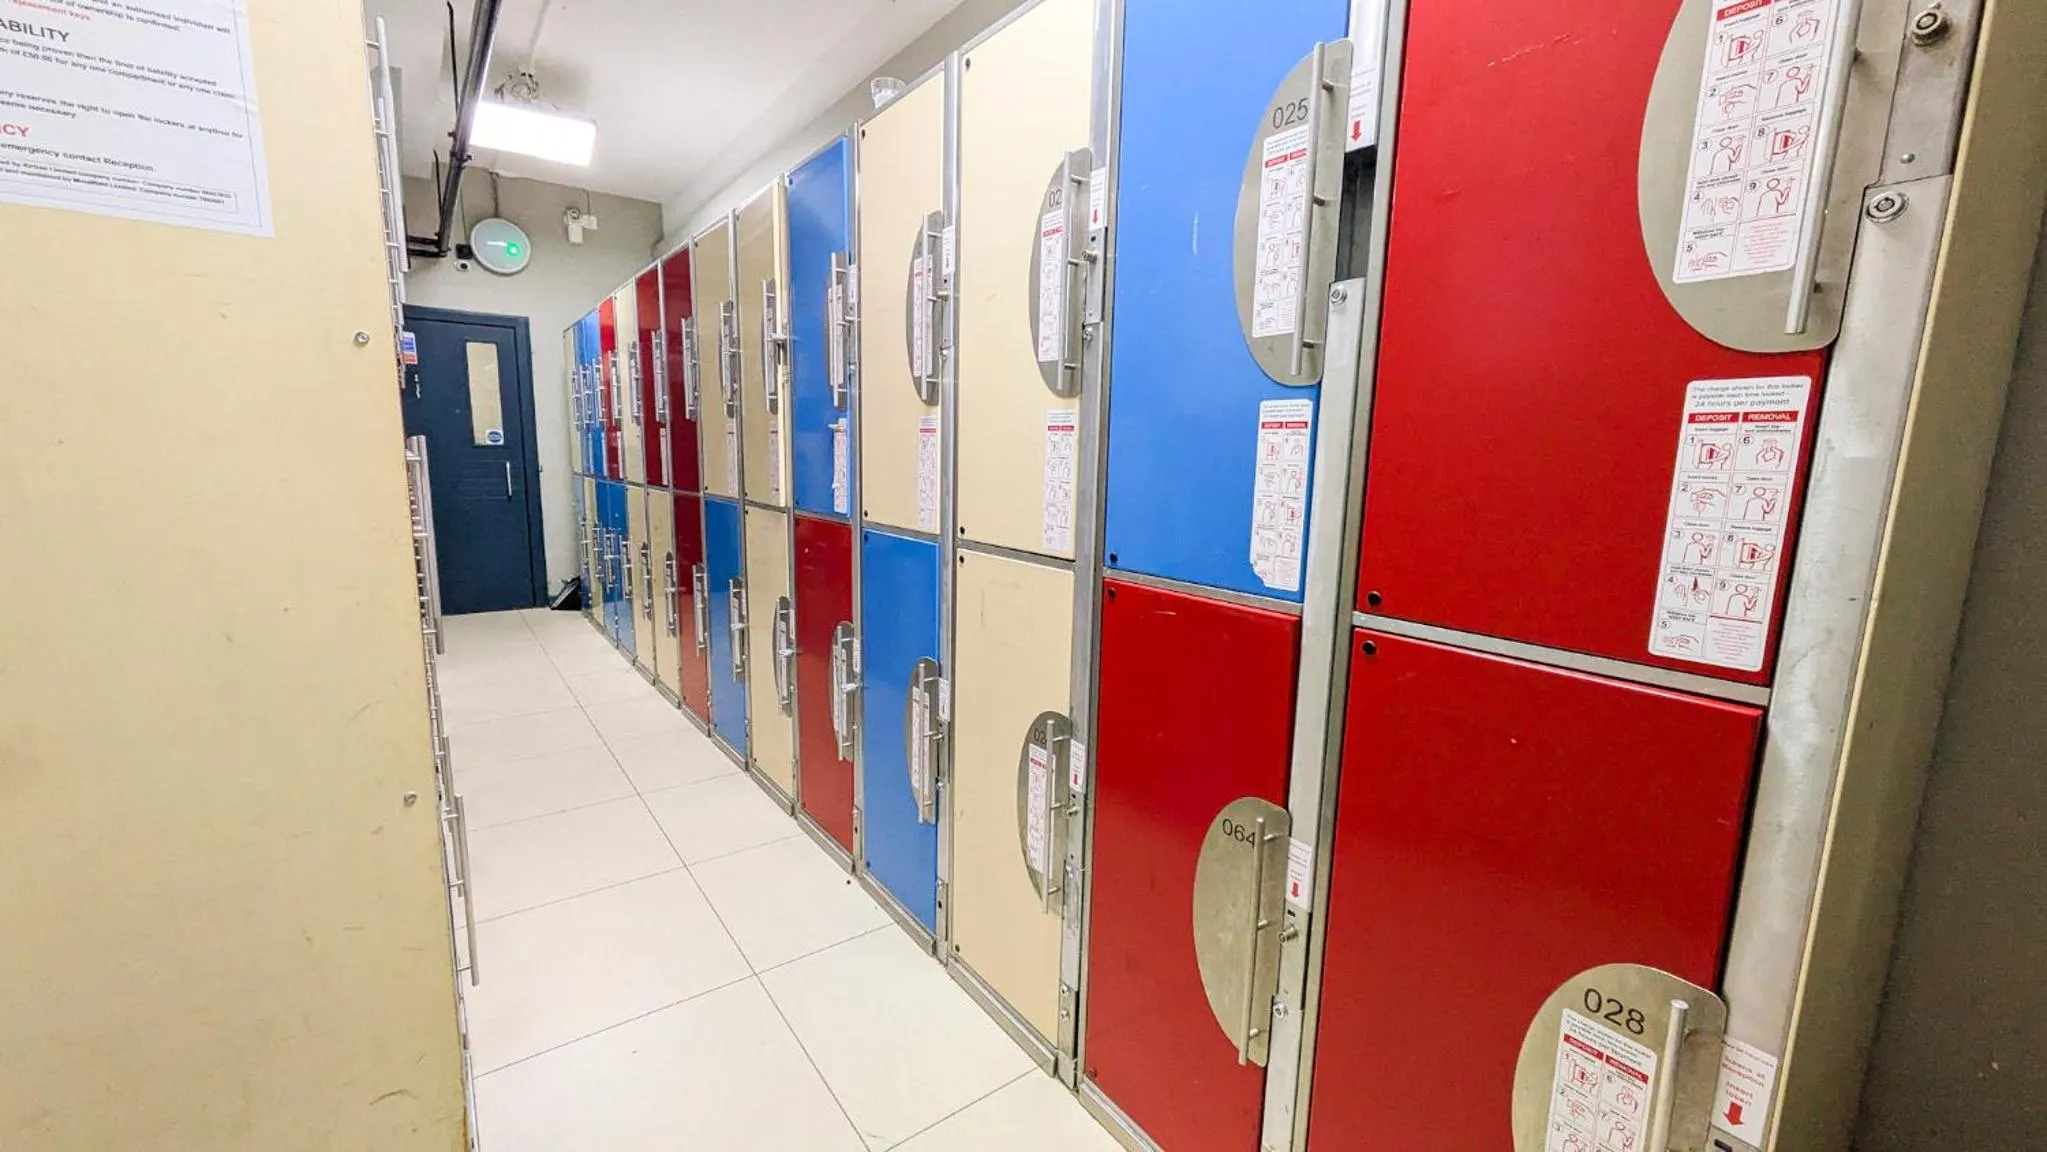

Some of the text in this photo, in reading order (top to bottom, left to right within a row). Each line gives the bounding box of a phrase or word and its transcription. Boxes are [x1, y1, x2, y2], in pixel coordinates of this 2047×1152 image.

[1775, 15, 1784, 26] 6
[1272, 97, 1309, 130] 025
[0, 123, 29, 137] CY
[0, 143, 60, 158] emergency
[62, 152, 101, 163] contact
[1733, 400, 1748, 408] per
[1750, 399, 1791, 408] payment
[1694, 412, 1792, 422] DEPOSIT REMOVAL
[1033, 728, 1047, 745] 02
[1222, 818, 1257, 849] 064
[1584, 988, 1646, 1035] 028
